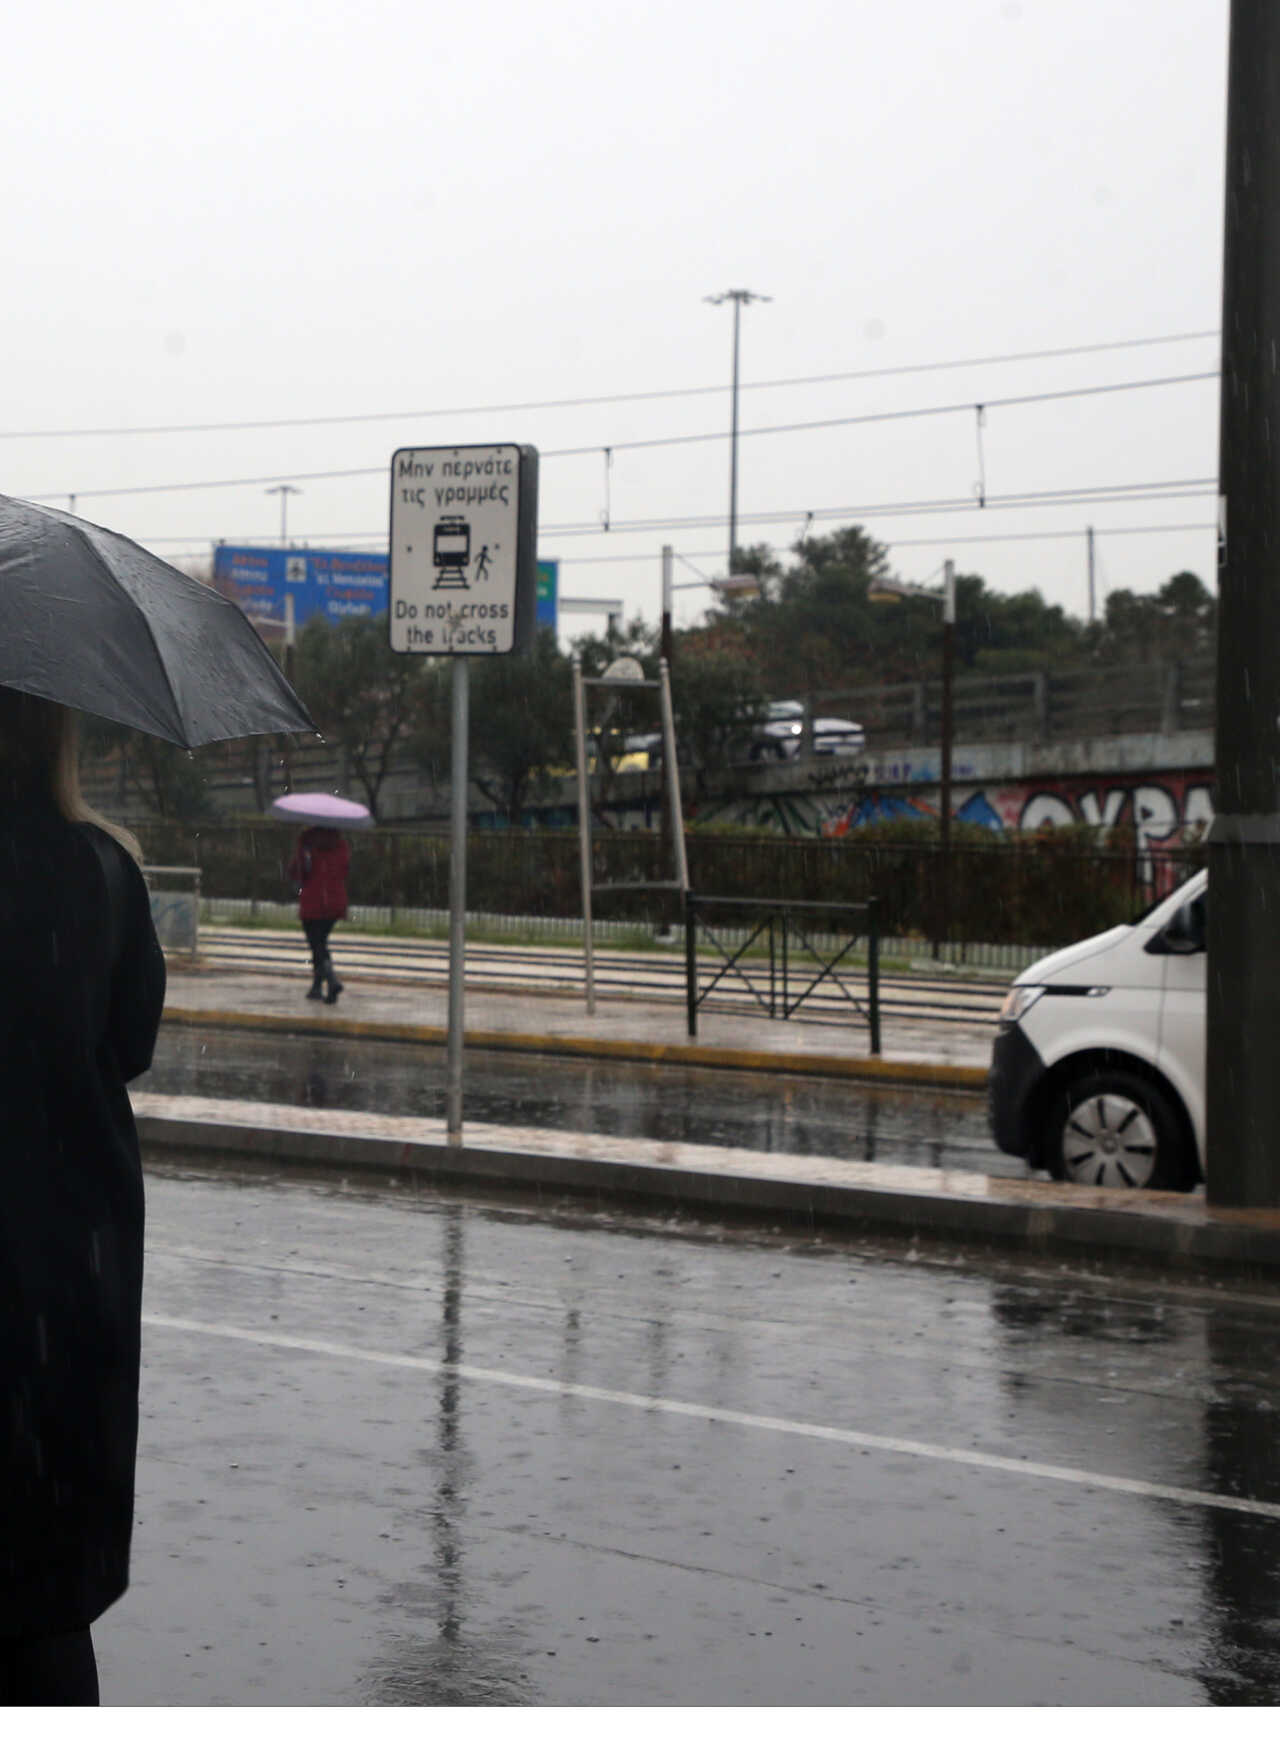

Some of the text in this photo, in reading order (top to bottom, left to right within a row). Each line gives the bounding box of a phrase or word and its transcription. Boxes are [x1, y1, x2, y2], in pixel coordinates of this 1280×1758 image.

[399, 456, 513, 480] Μην περνάτε
[402, 481, 510, 508] τις γραμμές
[395, 600, 509, 619] Do not cross
[407, 625, 433, 644] the
